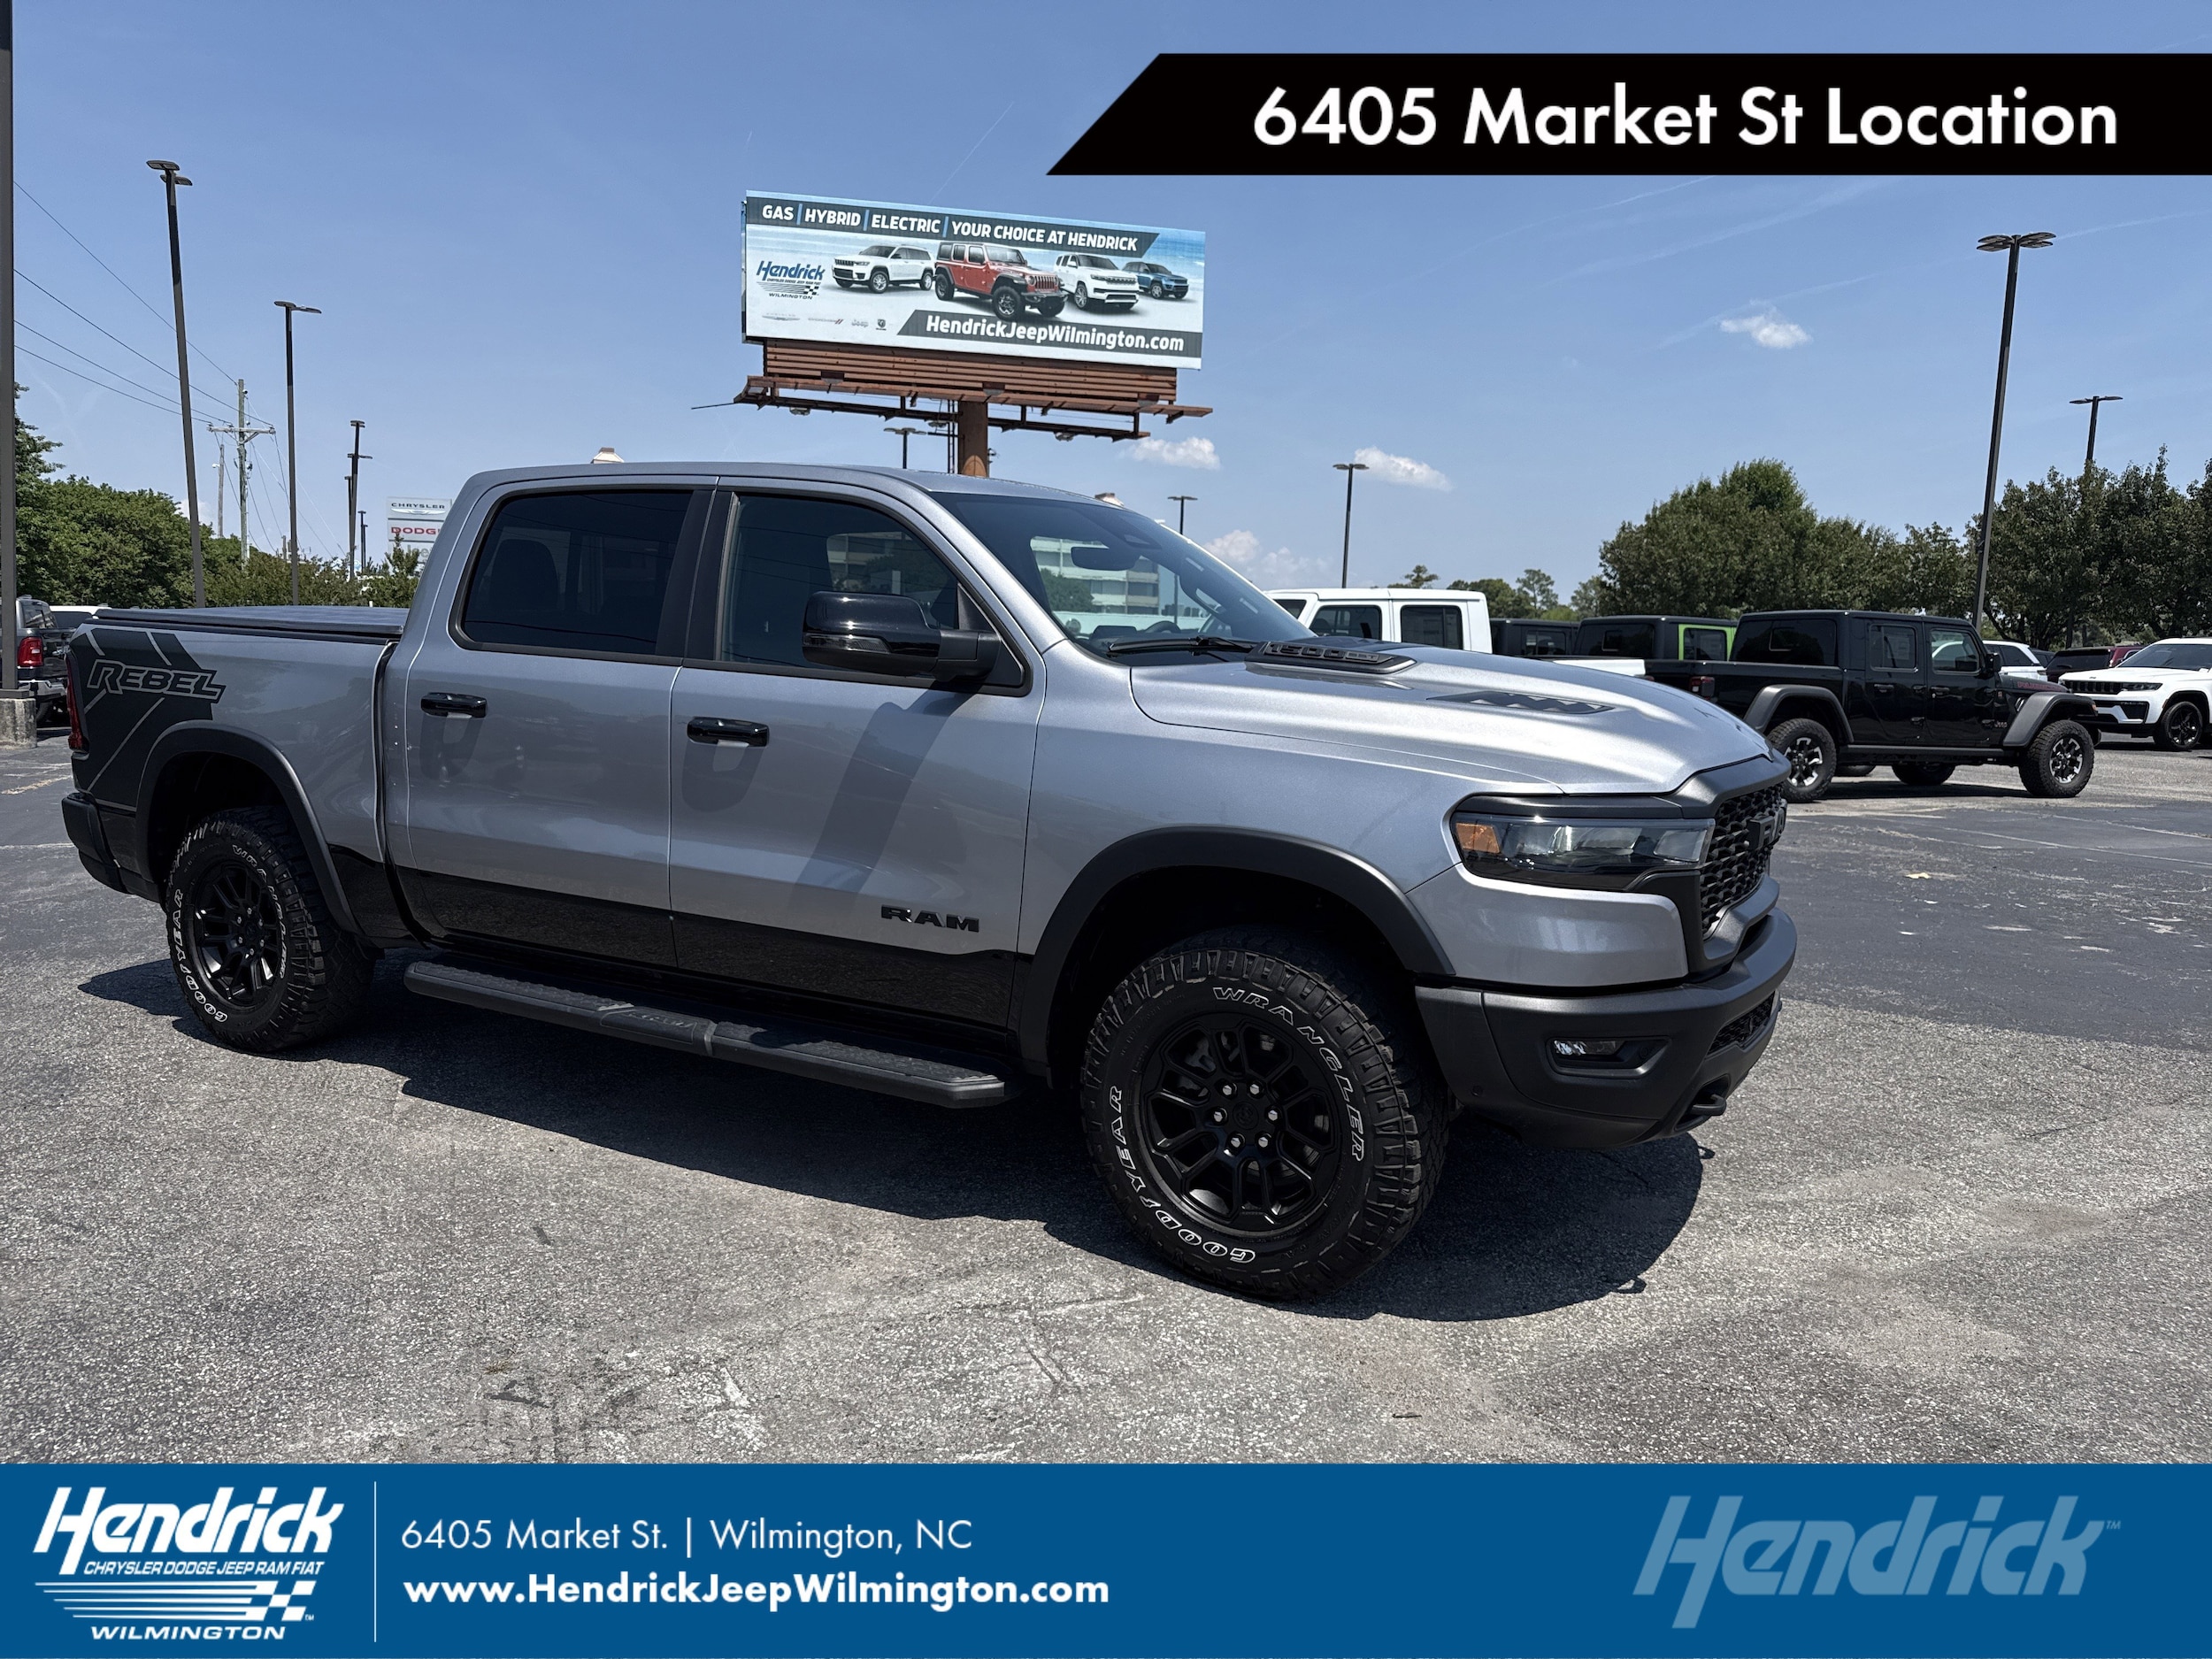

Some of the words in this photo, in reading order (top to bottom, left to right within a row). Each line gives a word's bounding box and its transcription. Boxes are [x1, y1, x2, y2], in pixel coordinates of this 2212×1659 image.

[762, 204, 795, 220] GAS
[804, 208, 862, 227] HYBRID
[871, 214, 941, 233] ELECTRIC
[951, 220, 992, 238] YOUR
[993, 225, 1046, 243] CHOICE
[1047, 231, 1067, 245] AT
[1067, 232, 1139, 251] HENDRICK
[756, 260, 826, 281] Hendrick
[926, 314, 1185, 351] HendrickJeepWilmington.com
[1270, 643, 1346, 659] 1500
[87, 658, 226, 703] REBEL
[881, 904, 979, 933] RAM
[171, 889, 228, 1023] GOODYEAR
[1212, 986, 1366, 1163] WRANGLER
[1107, 1085, 1256, 1264] GOODYEAR
